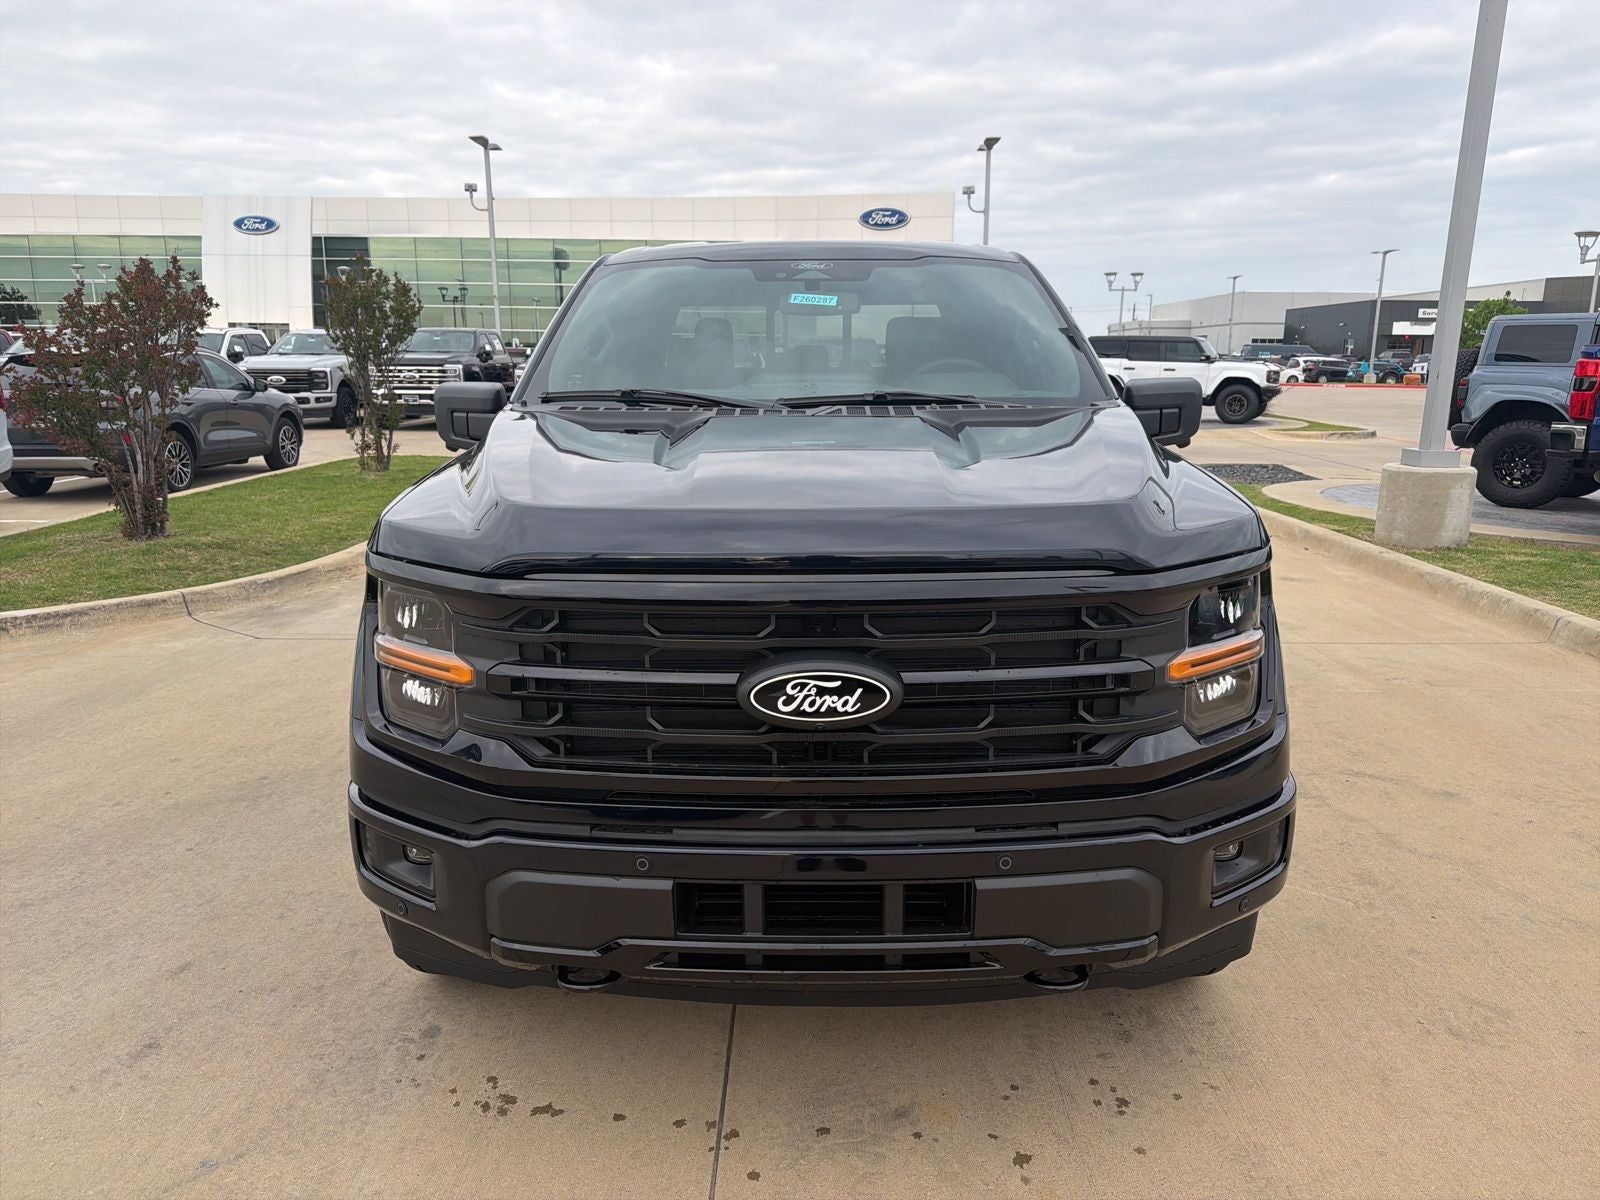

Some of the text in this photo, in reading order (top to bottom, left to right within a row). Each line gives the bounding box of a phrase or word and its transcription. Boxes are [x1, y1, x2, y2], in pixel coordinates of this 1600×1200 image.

[241, 218, 267, 229] Ford
[869, 211, 899, 225] Ford
[793, 295, 834, 304] F260287
[777, 679, 863, 712] Ford
